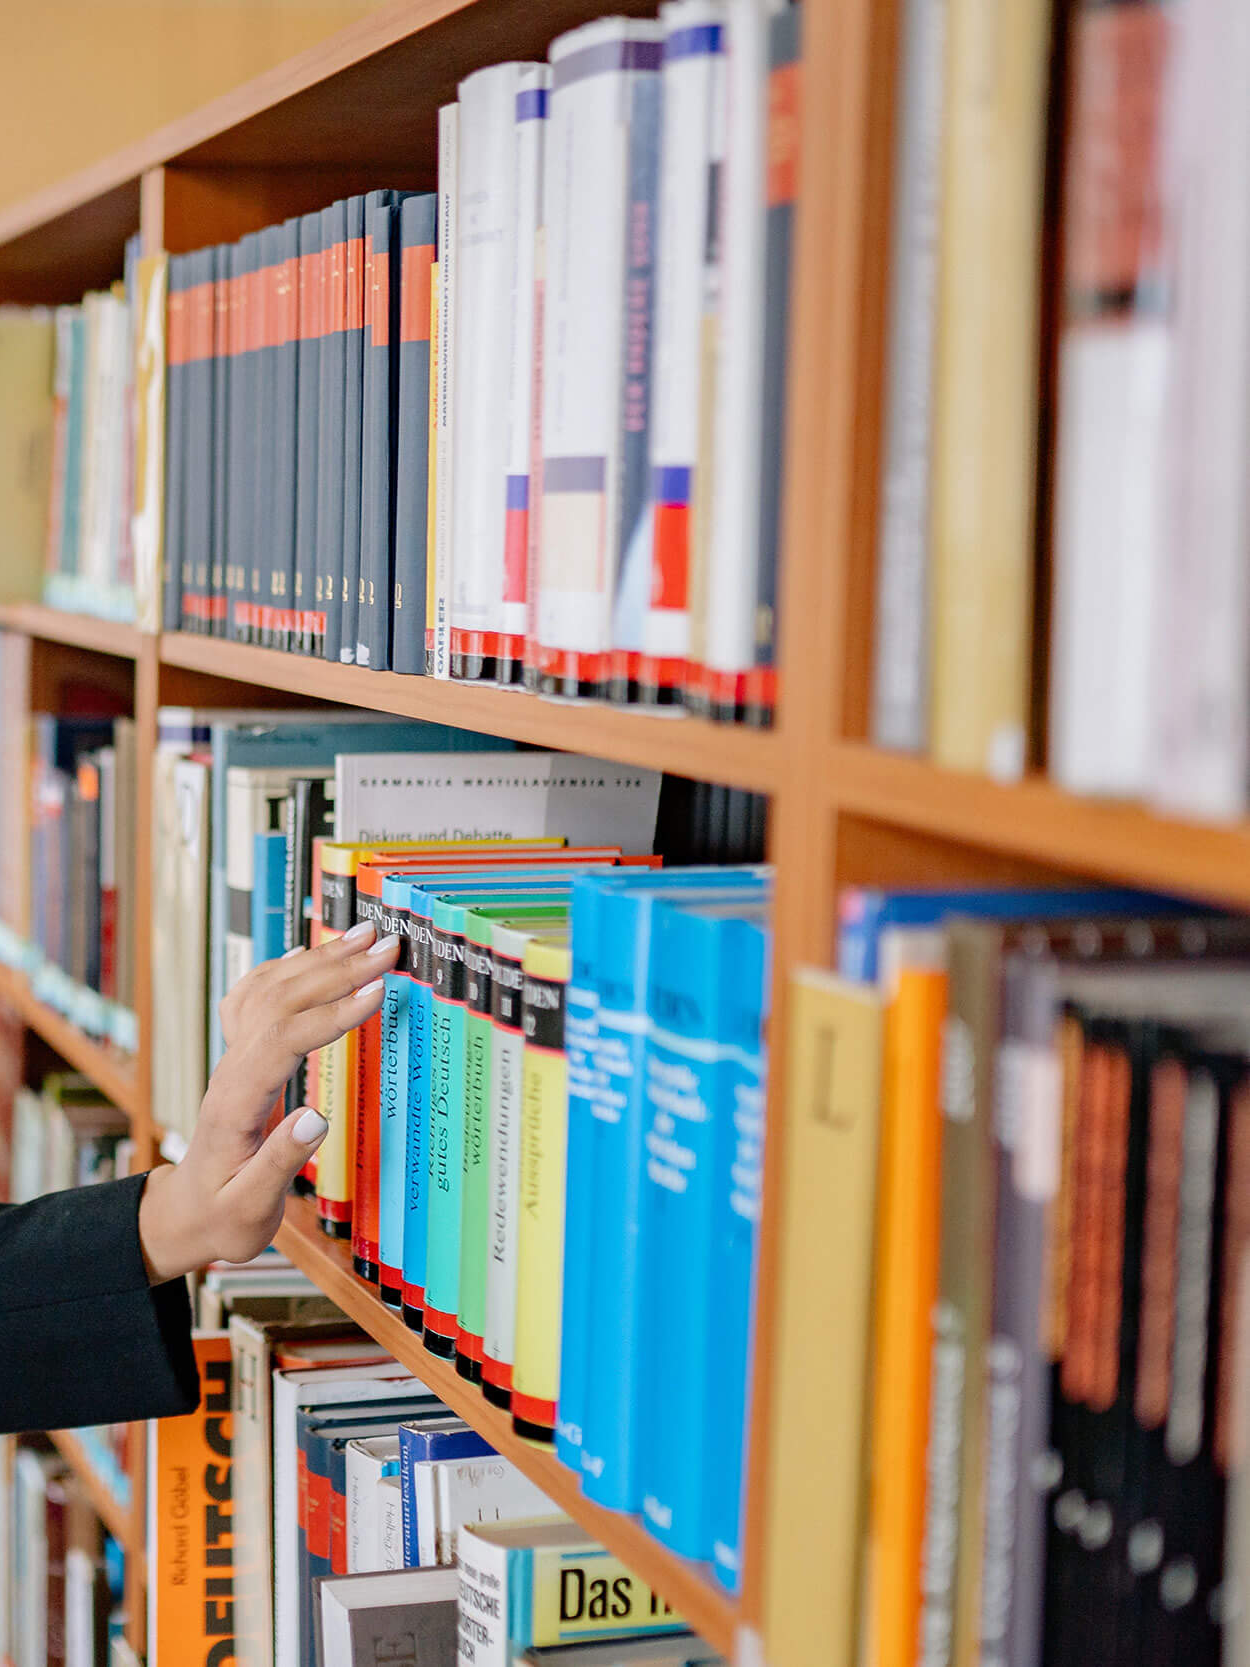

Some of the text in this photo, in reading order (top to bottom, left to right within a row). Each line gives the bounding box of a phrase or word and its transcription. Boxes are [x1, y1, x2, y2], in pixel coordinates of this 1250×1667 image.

[359, 778, 453, 788] GERMANICA
[359, 829, 412, 844] Diskurs
[418, 828, 448, 842] und
[386, 988, 399, 1119] wörterbuch
[412, 998, 425, 1081] Wörter
[471, 1035, 484, 1166] wörterbuch
[409, 1091, 422, 1212] verwandte
[435, 1017, 451, 1193] gutes Deutsch
[492, 1048, 513, 1264] Redewendungen
[401, 1444, 411, 1567] iteraturlexikon
[559, 1568, 632, 1622] Das
